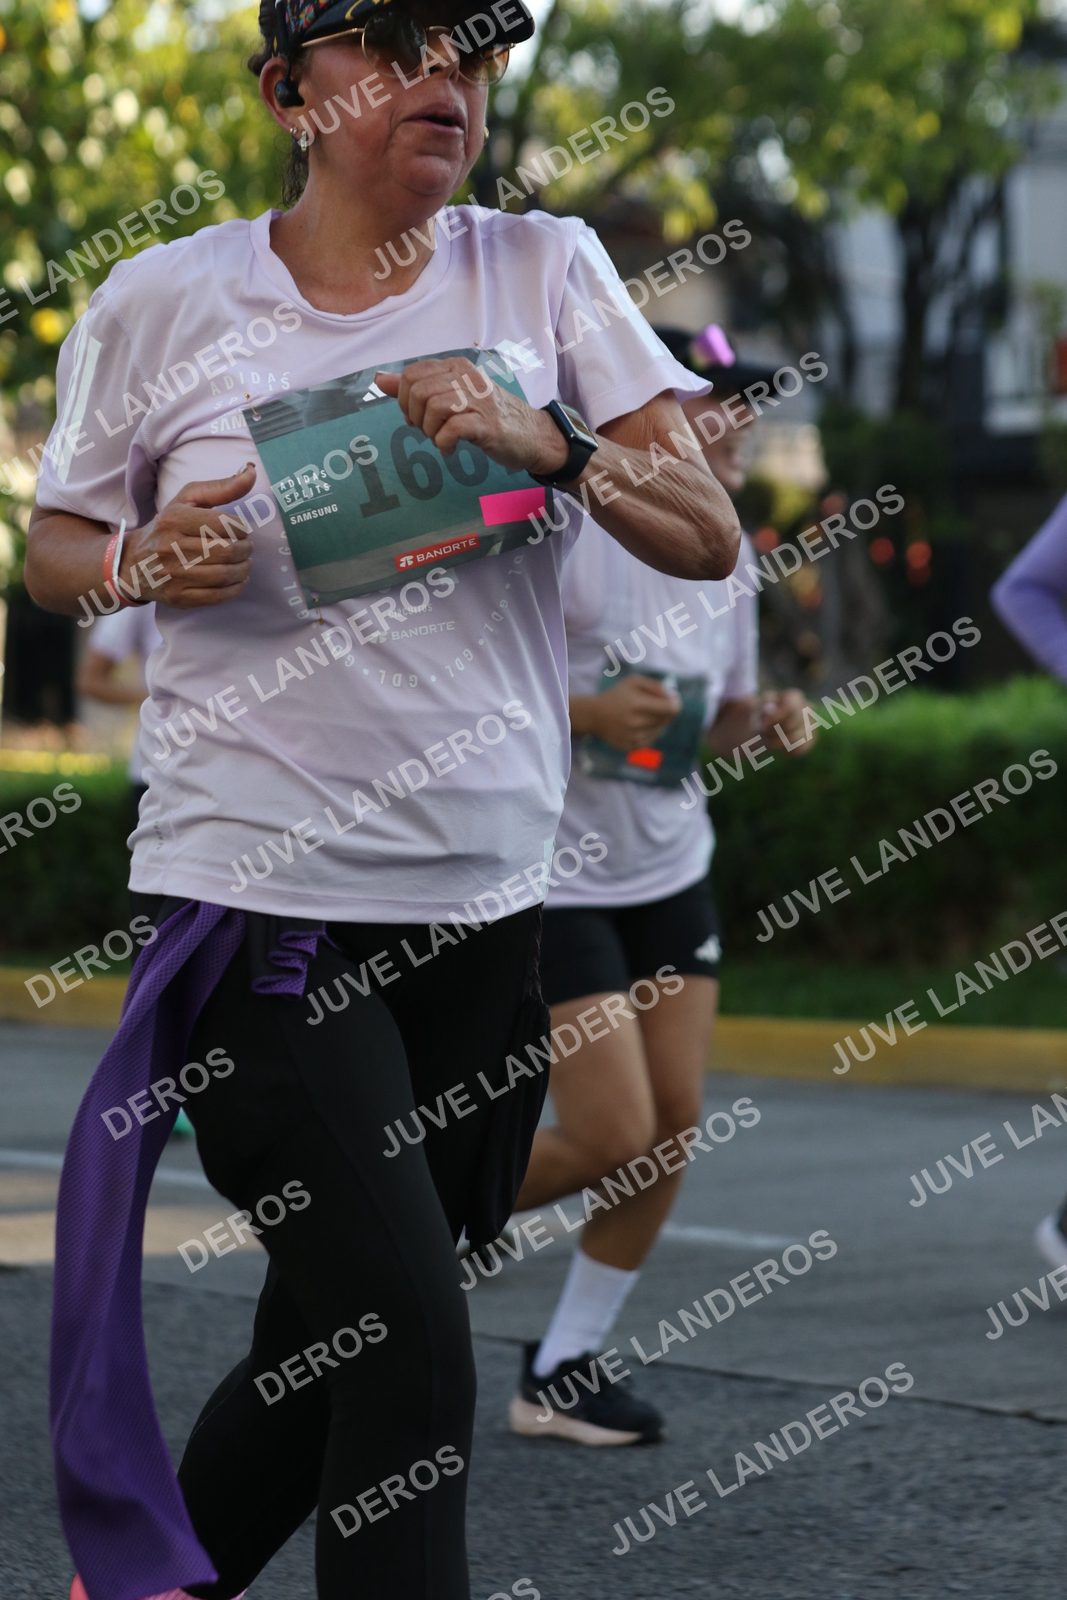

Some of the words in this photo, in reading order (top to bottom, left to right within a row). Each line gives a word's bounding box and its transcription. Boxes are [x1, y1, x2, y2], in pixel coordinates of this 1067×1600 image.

[280, 469, 327, 491] ADIDAS
[350, 424, 527, 518] 166
[284, 482, 330, 503] SPLITS
[290, 503, 338, 525] SAMSUNG
[416, 538, 477, 563] BANORTE
[391, 620, 456, 641] BANORTE
